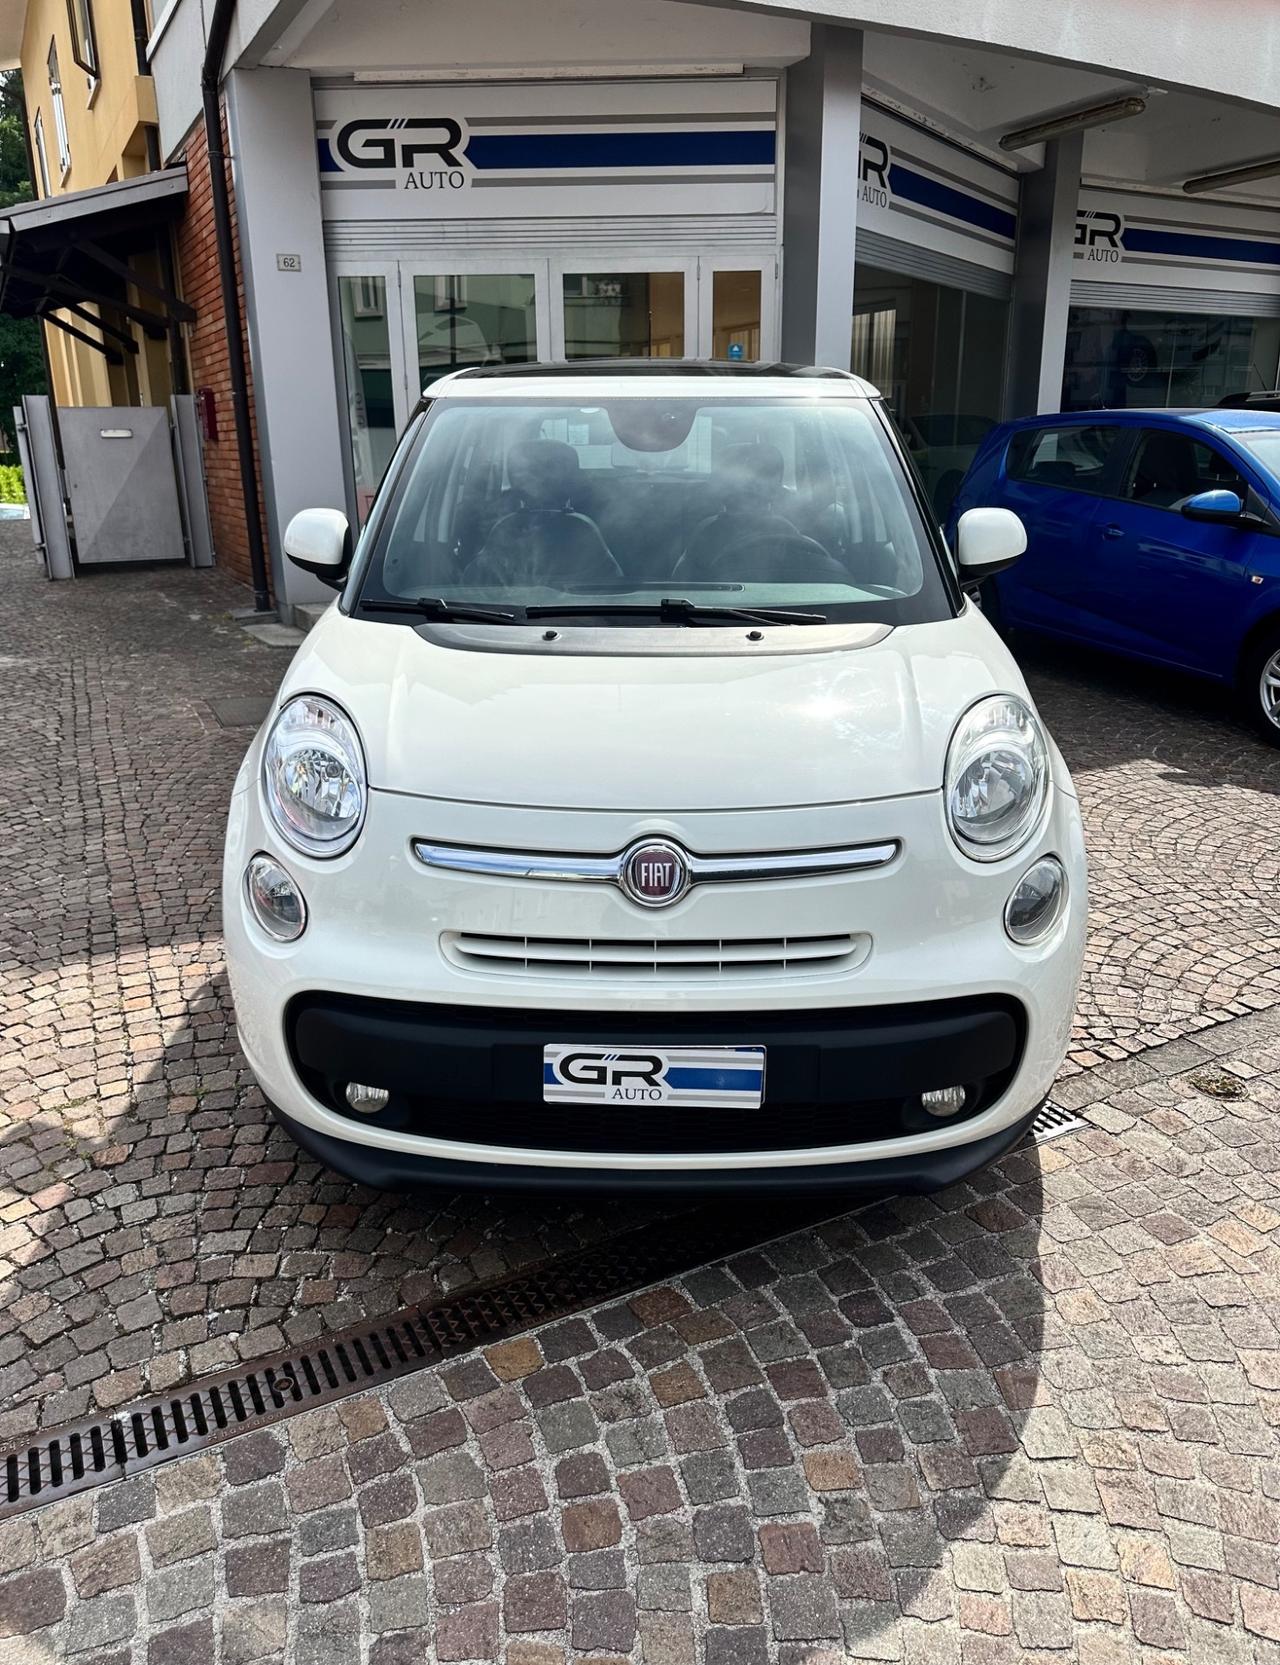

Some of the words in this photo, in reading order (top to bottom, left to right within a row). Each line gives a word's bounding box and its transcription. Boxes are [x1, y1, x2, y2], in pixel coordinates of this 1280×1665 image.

[337, 118, 463, 168] GR
[404, 171, 465, 189] AUTO
[862, 185, 887, 208] AUTO
[283, 257, 295, 268] 62
[1087, 248, 1119, 263] AUTO
[641, 862, 672, 887] FIAT
[559, 1053, 663, 1087] GR
[612, 1088, 662, 1100] AUTO
